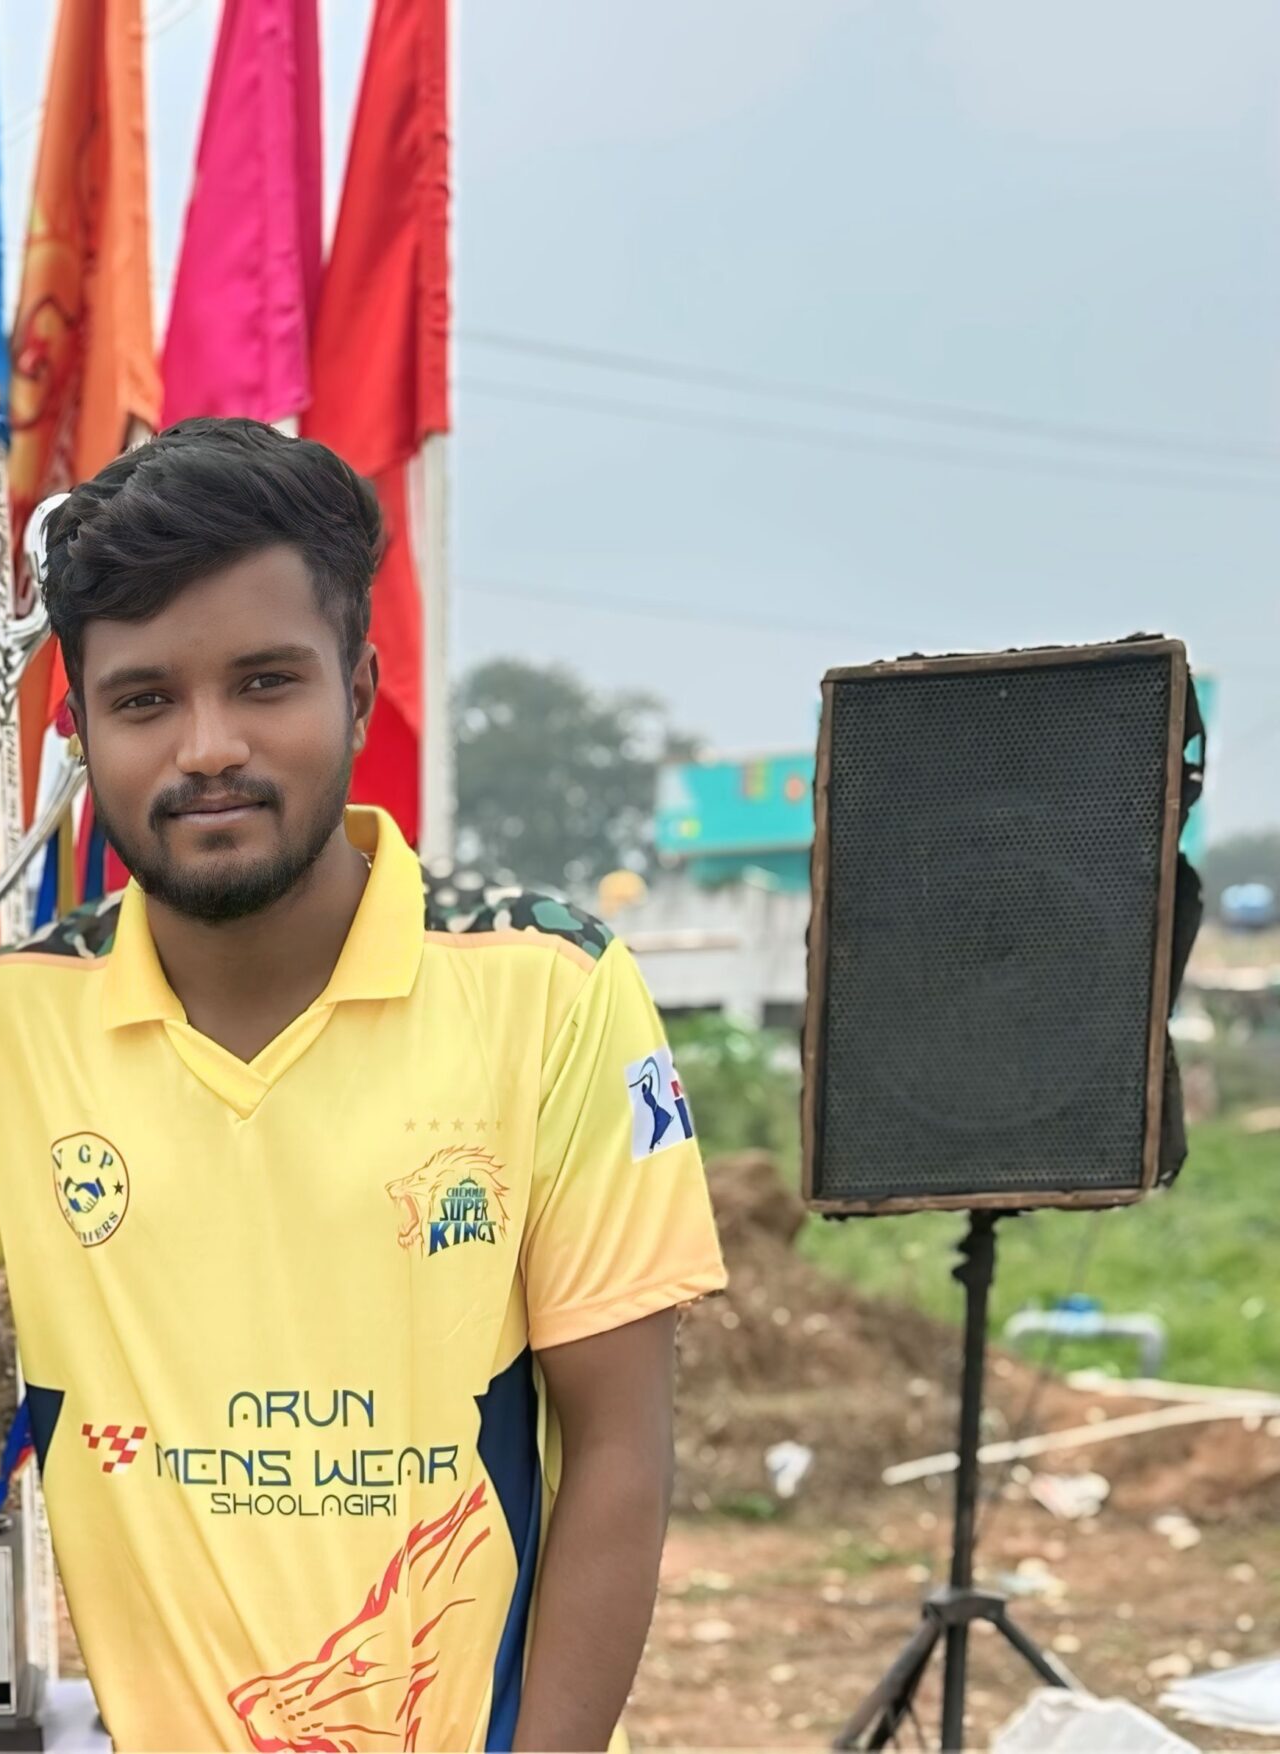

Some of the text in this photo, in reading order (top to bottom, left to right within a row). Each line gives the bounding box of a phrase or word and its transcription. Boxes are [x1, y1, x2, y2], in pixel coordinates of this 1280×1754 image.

[439, 1198, 488, 1221] SUPER
[428, 1221, 496, 1257] KINGS
[228, 1390, 374, 1428] ARUN
[155, 1442, 459, 1487] MENS WEAR
[210, 1492, 397, 1517] SHOOLAGIRI
